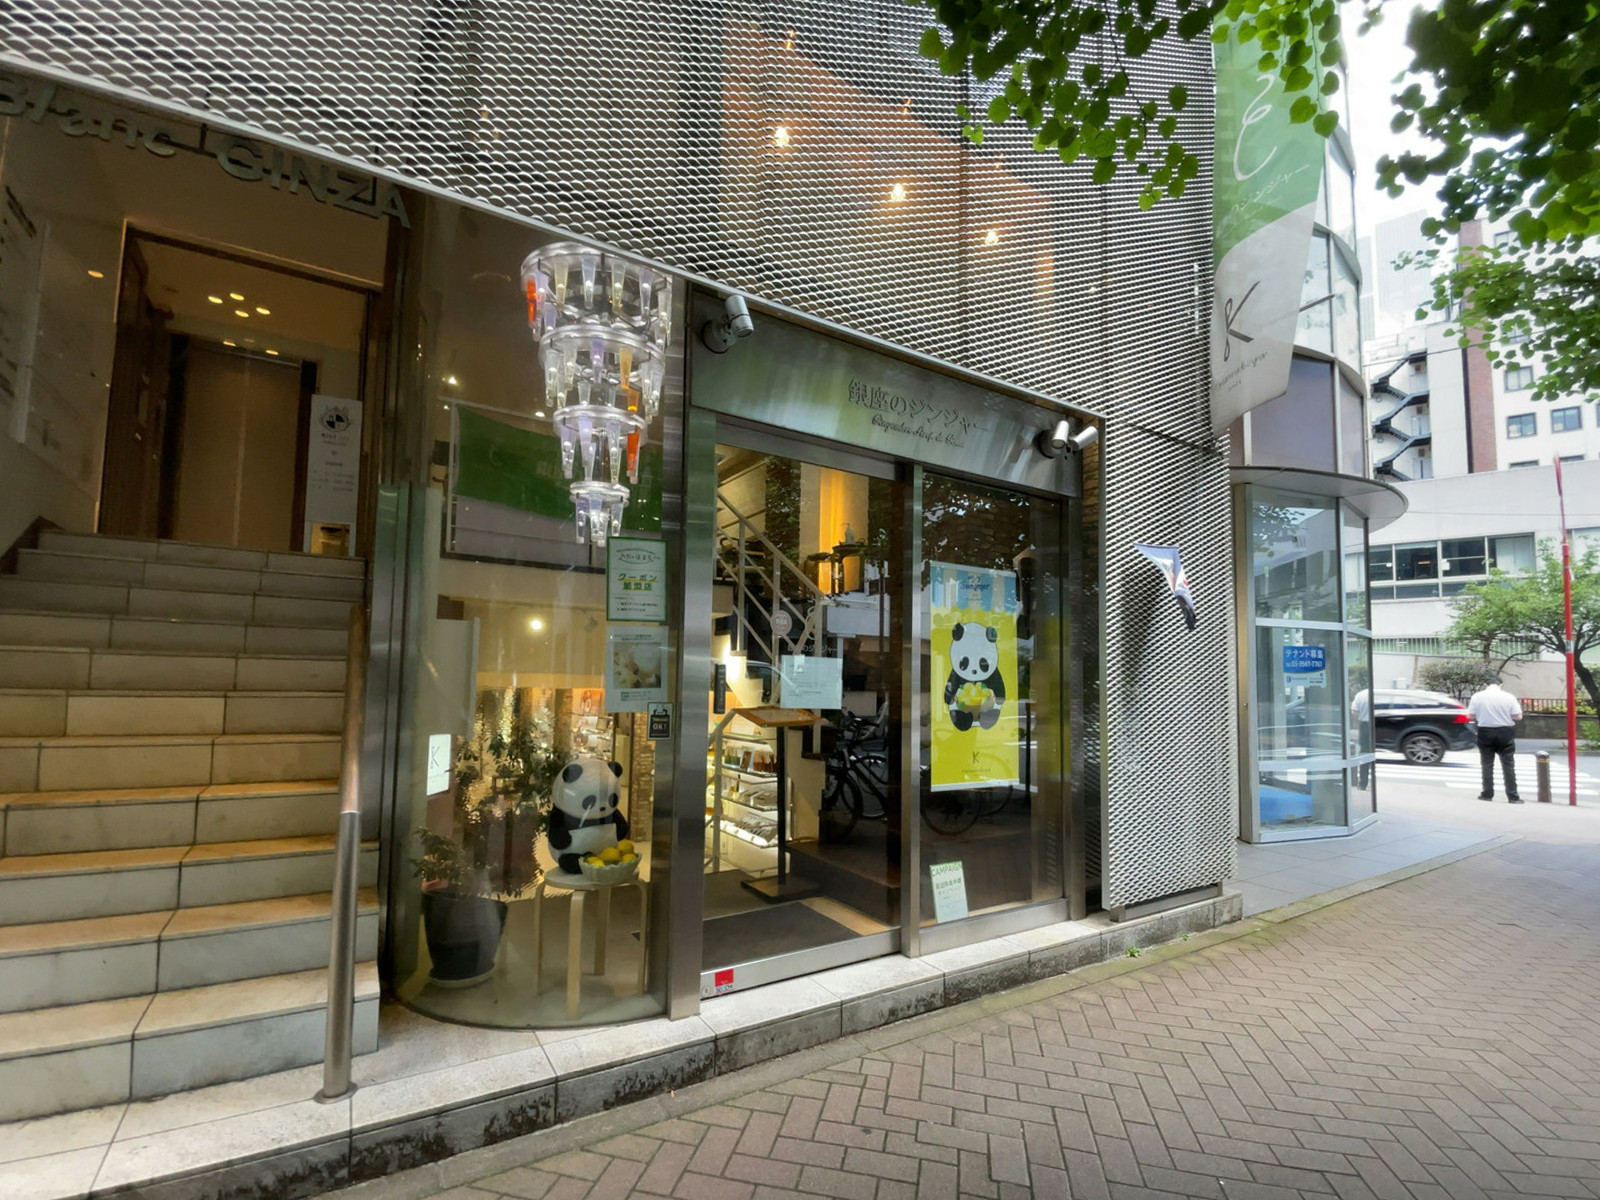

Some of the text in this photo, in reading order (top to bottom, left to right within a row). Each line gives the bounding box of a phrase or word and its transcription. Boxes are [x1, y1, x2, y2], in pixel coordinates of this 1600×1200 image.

[217, 140, 411, 229] GINZA
[1223, 280, 1261, 362] K
[848, 378, 988, 434] 銀座のジンジャー
[617, 573, 657, 583] クーポン
[1285, 649, 1324, 659] テナント募集
